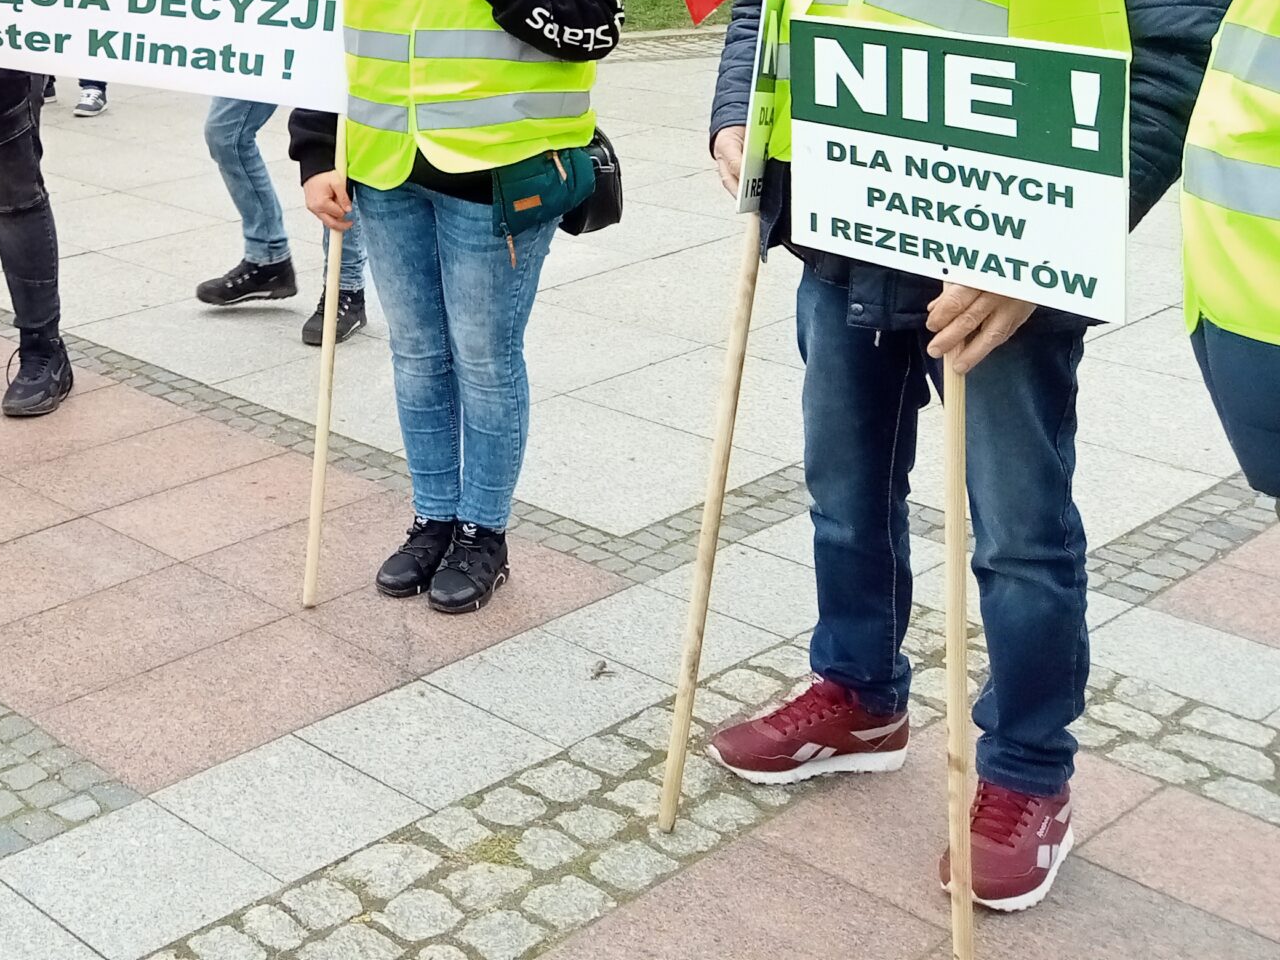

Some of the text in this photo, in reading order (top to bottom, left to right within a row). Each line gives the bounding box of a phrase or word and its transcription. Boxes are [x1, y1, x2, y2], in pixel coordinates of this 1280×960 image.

[88, 28, 264, 77] Klimatu
[814, 36, 1018, 139] NIE
[826, 141, 1074, 208] DLA NOWYCH
[866, 186, 1027, 240] PARKÓW
[810, 212, 1098, 300] I REZERWATÓW
